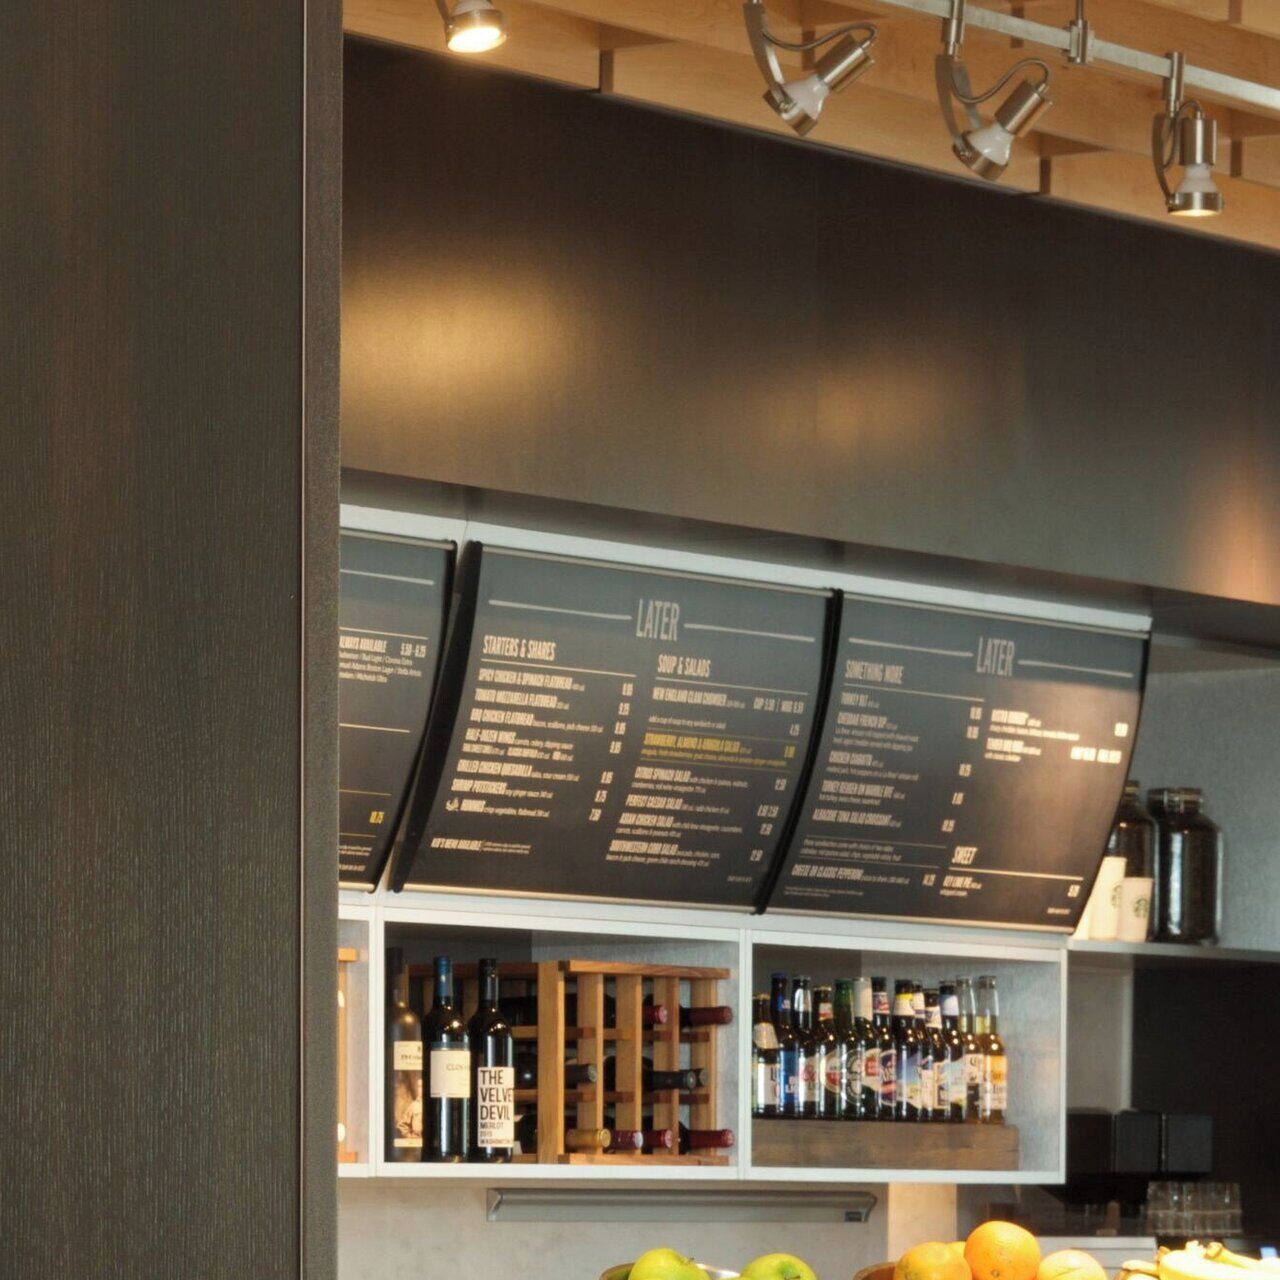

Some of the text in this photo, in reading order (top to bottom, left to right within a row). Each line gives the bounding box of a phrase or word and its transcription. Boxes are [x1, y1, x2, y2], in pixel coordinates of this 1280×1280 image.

[636, 599, 680, 641] LATER
[483, 635, 519, 657] STARTERS
[528, 640, 557, 661] SHARES
[976, 636, 1015, 677] LATER
[658, 654, 677, 674] SOUP
[481, 1070, 503, 1085] THE
[481, 1105, 510, 1120] DEVIL
